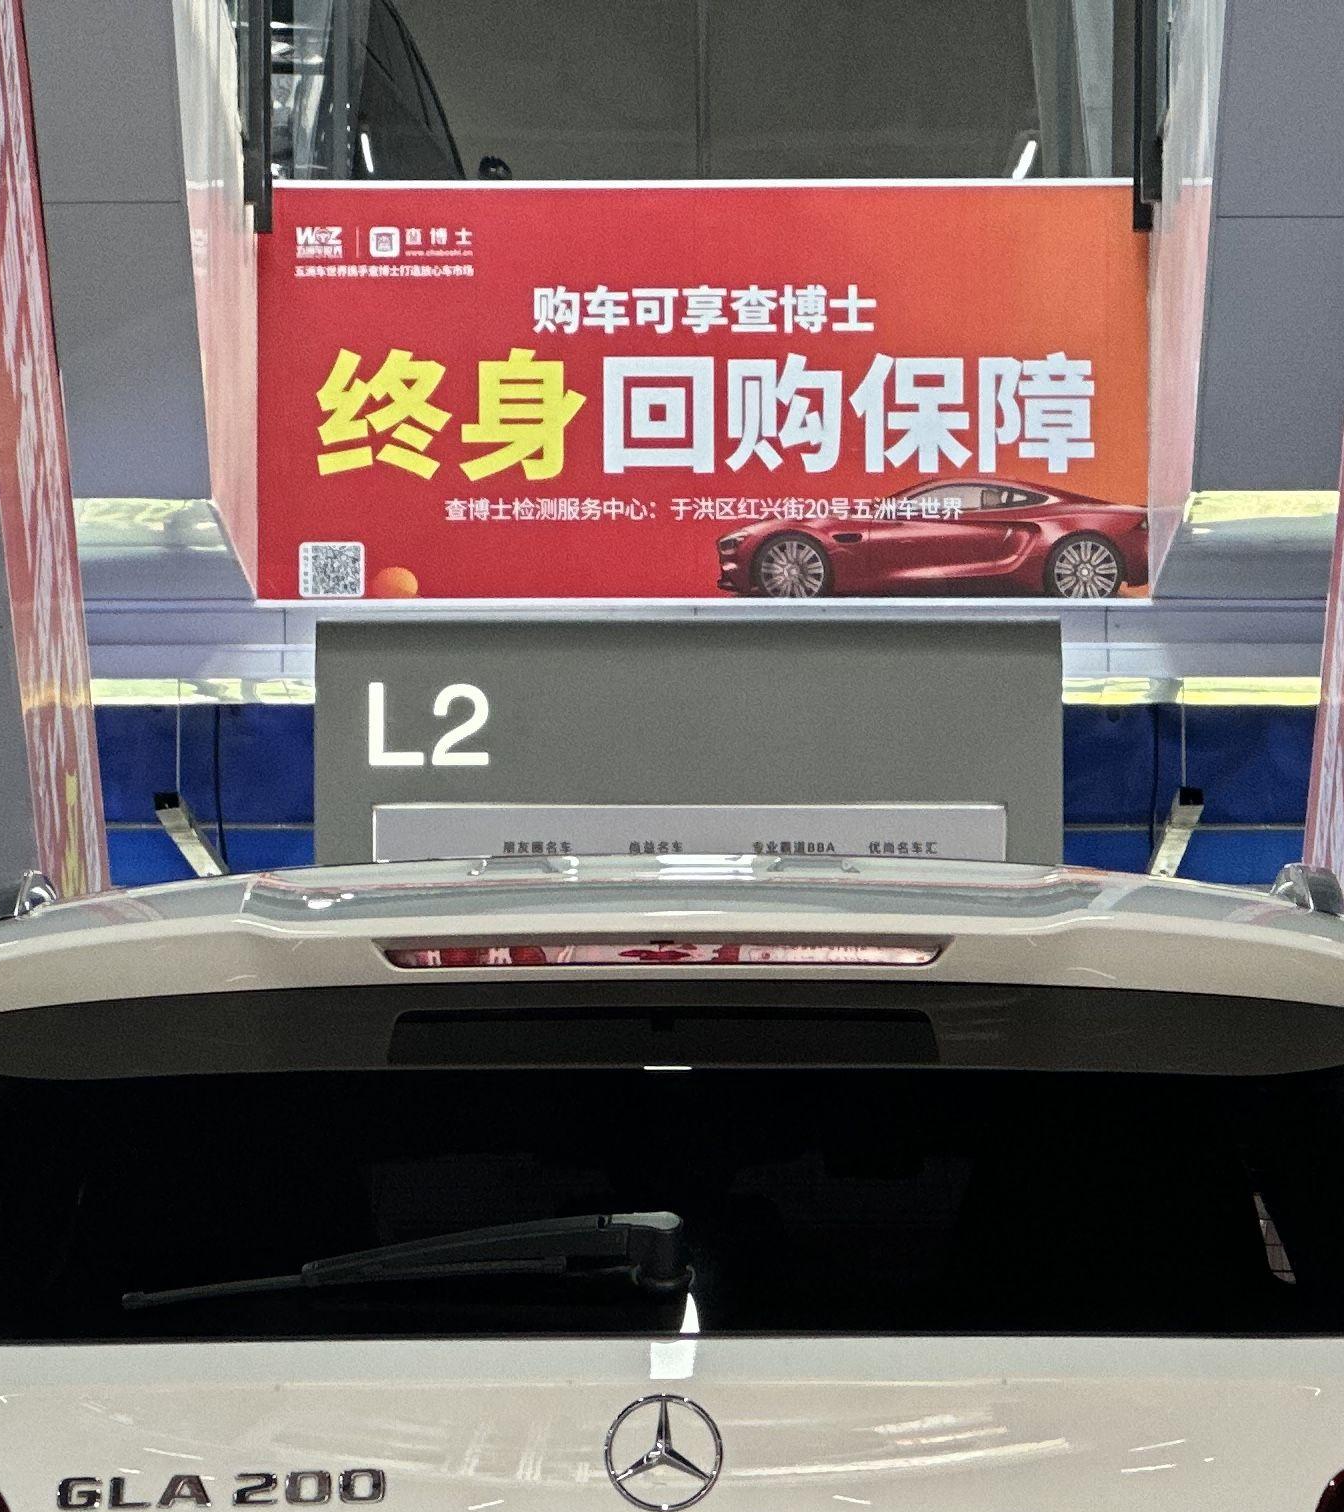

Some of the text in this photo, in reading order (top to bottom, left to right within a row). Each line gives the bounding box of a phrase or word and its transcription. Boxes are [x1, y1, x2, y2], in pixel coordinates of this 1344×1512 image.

[532, 285, 877, 335] 购车可享查博士
[316, 348, 1097, 481] 终身回购保障
[368, 681, 490, 767] L2
[57, 1468, 387, 1510] GLA 200
